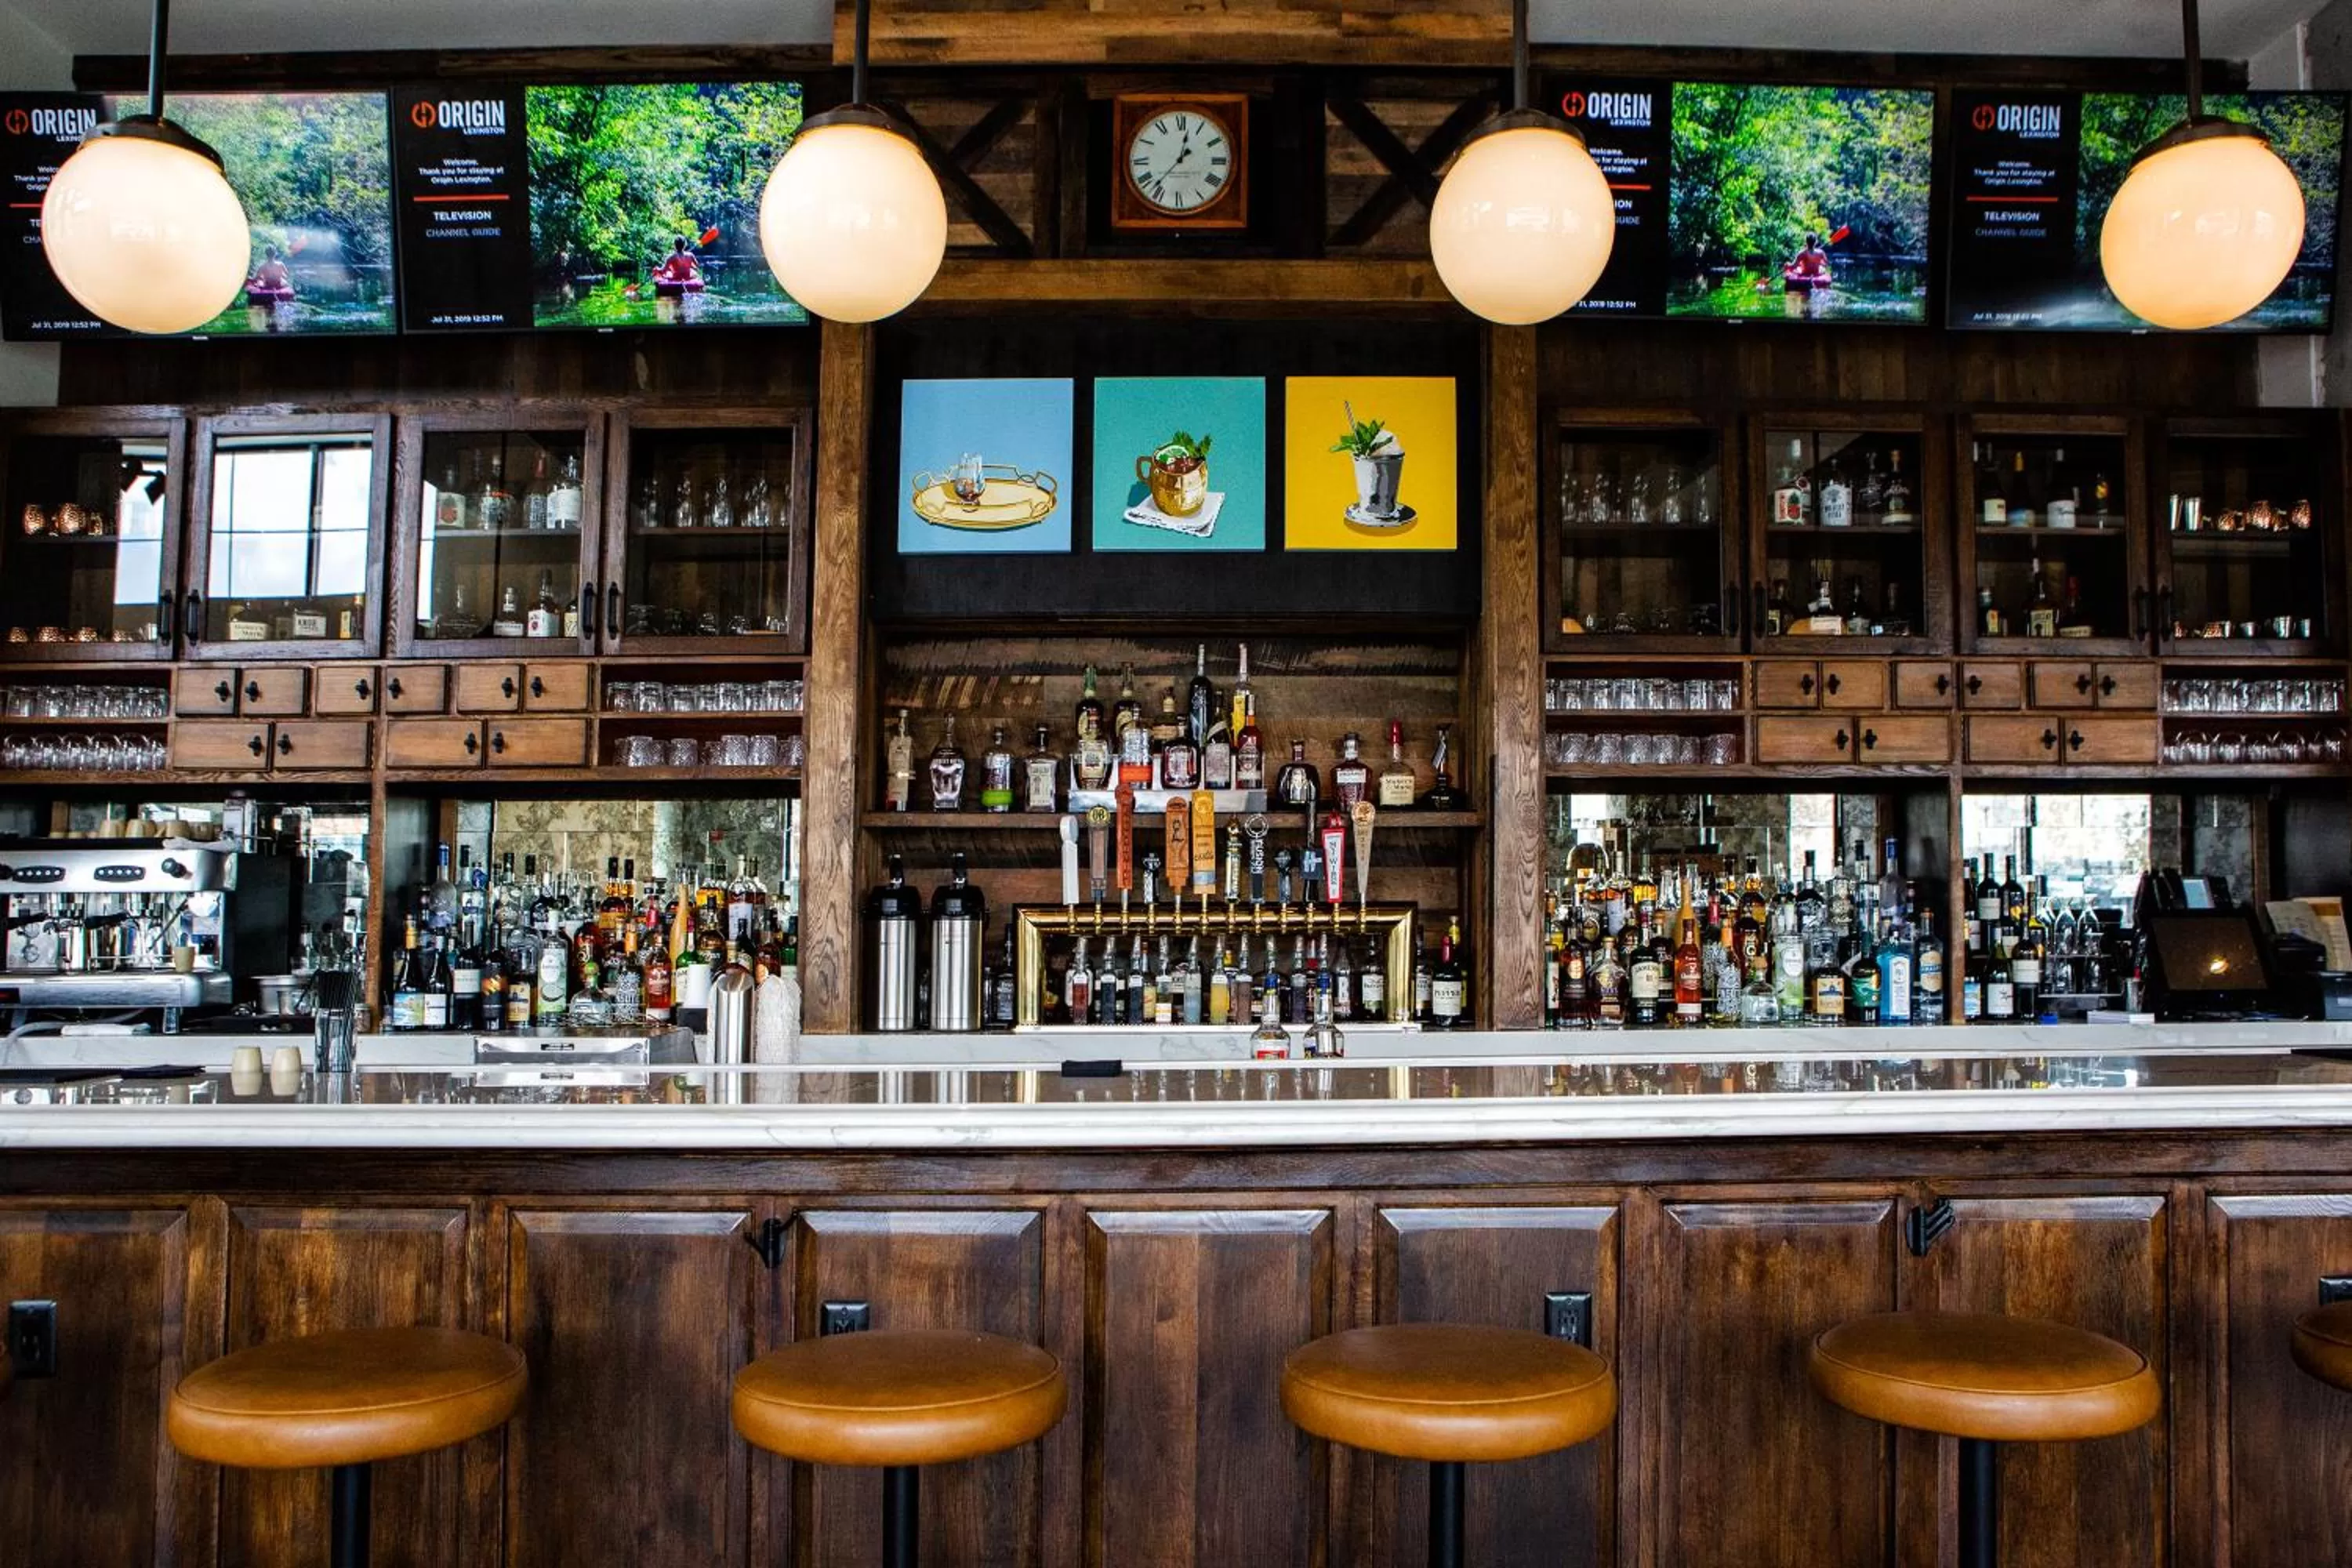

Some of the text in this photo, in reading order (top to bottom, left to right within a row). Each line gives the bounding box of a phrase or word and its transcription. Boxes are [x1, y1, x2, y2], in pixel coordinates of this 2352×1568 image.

[1588, 93, 1652, 118] ORIGIN
[438, 100, 505, 128] ORIGIN
[1997, 104, 2061, 131] ORIGIN
[31, 108, 96, 135] ORIGIN
[430, 176, 454, 184] Origin
[433, 210, 492, 221] TELEVISION
[1984, 211, 2040, 221] TELEVISION
[426, 227, 502, 238] CHANNEL GUIDE
[1975, 227, 2047, 237] CHANNEL GUIDE
